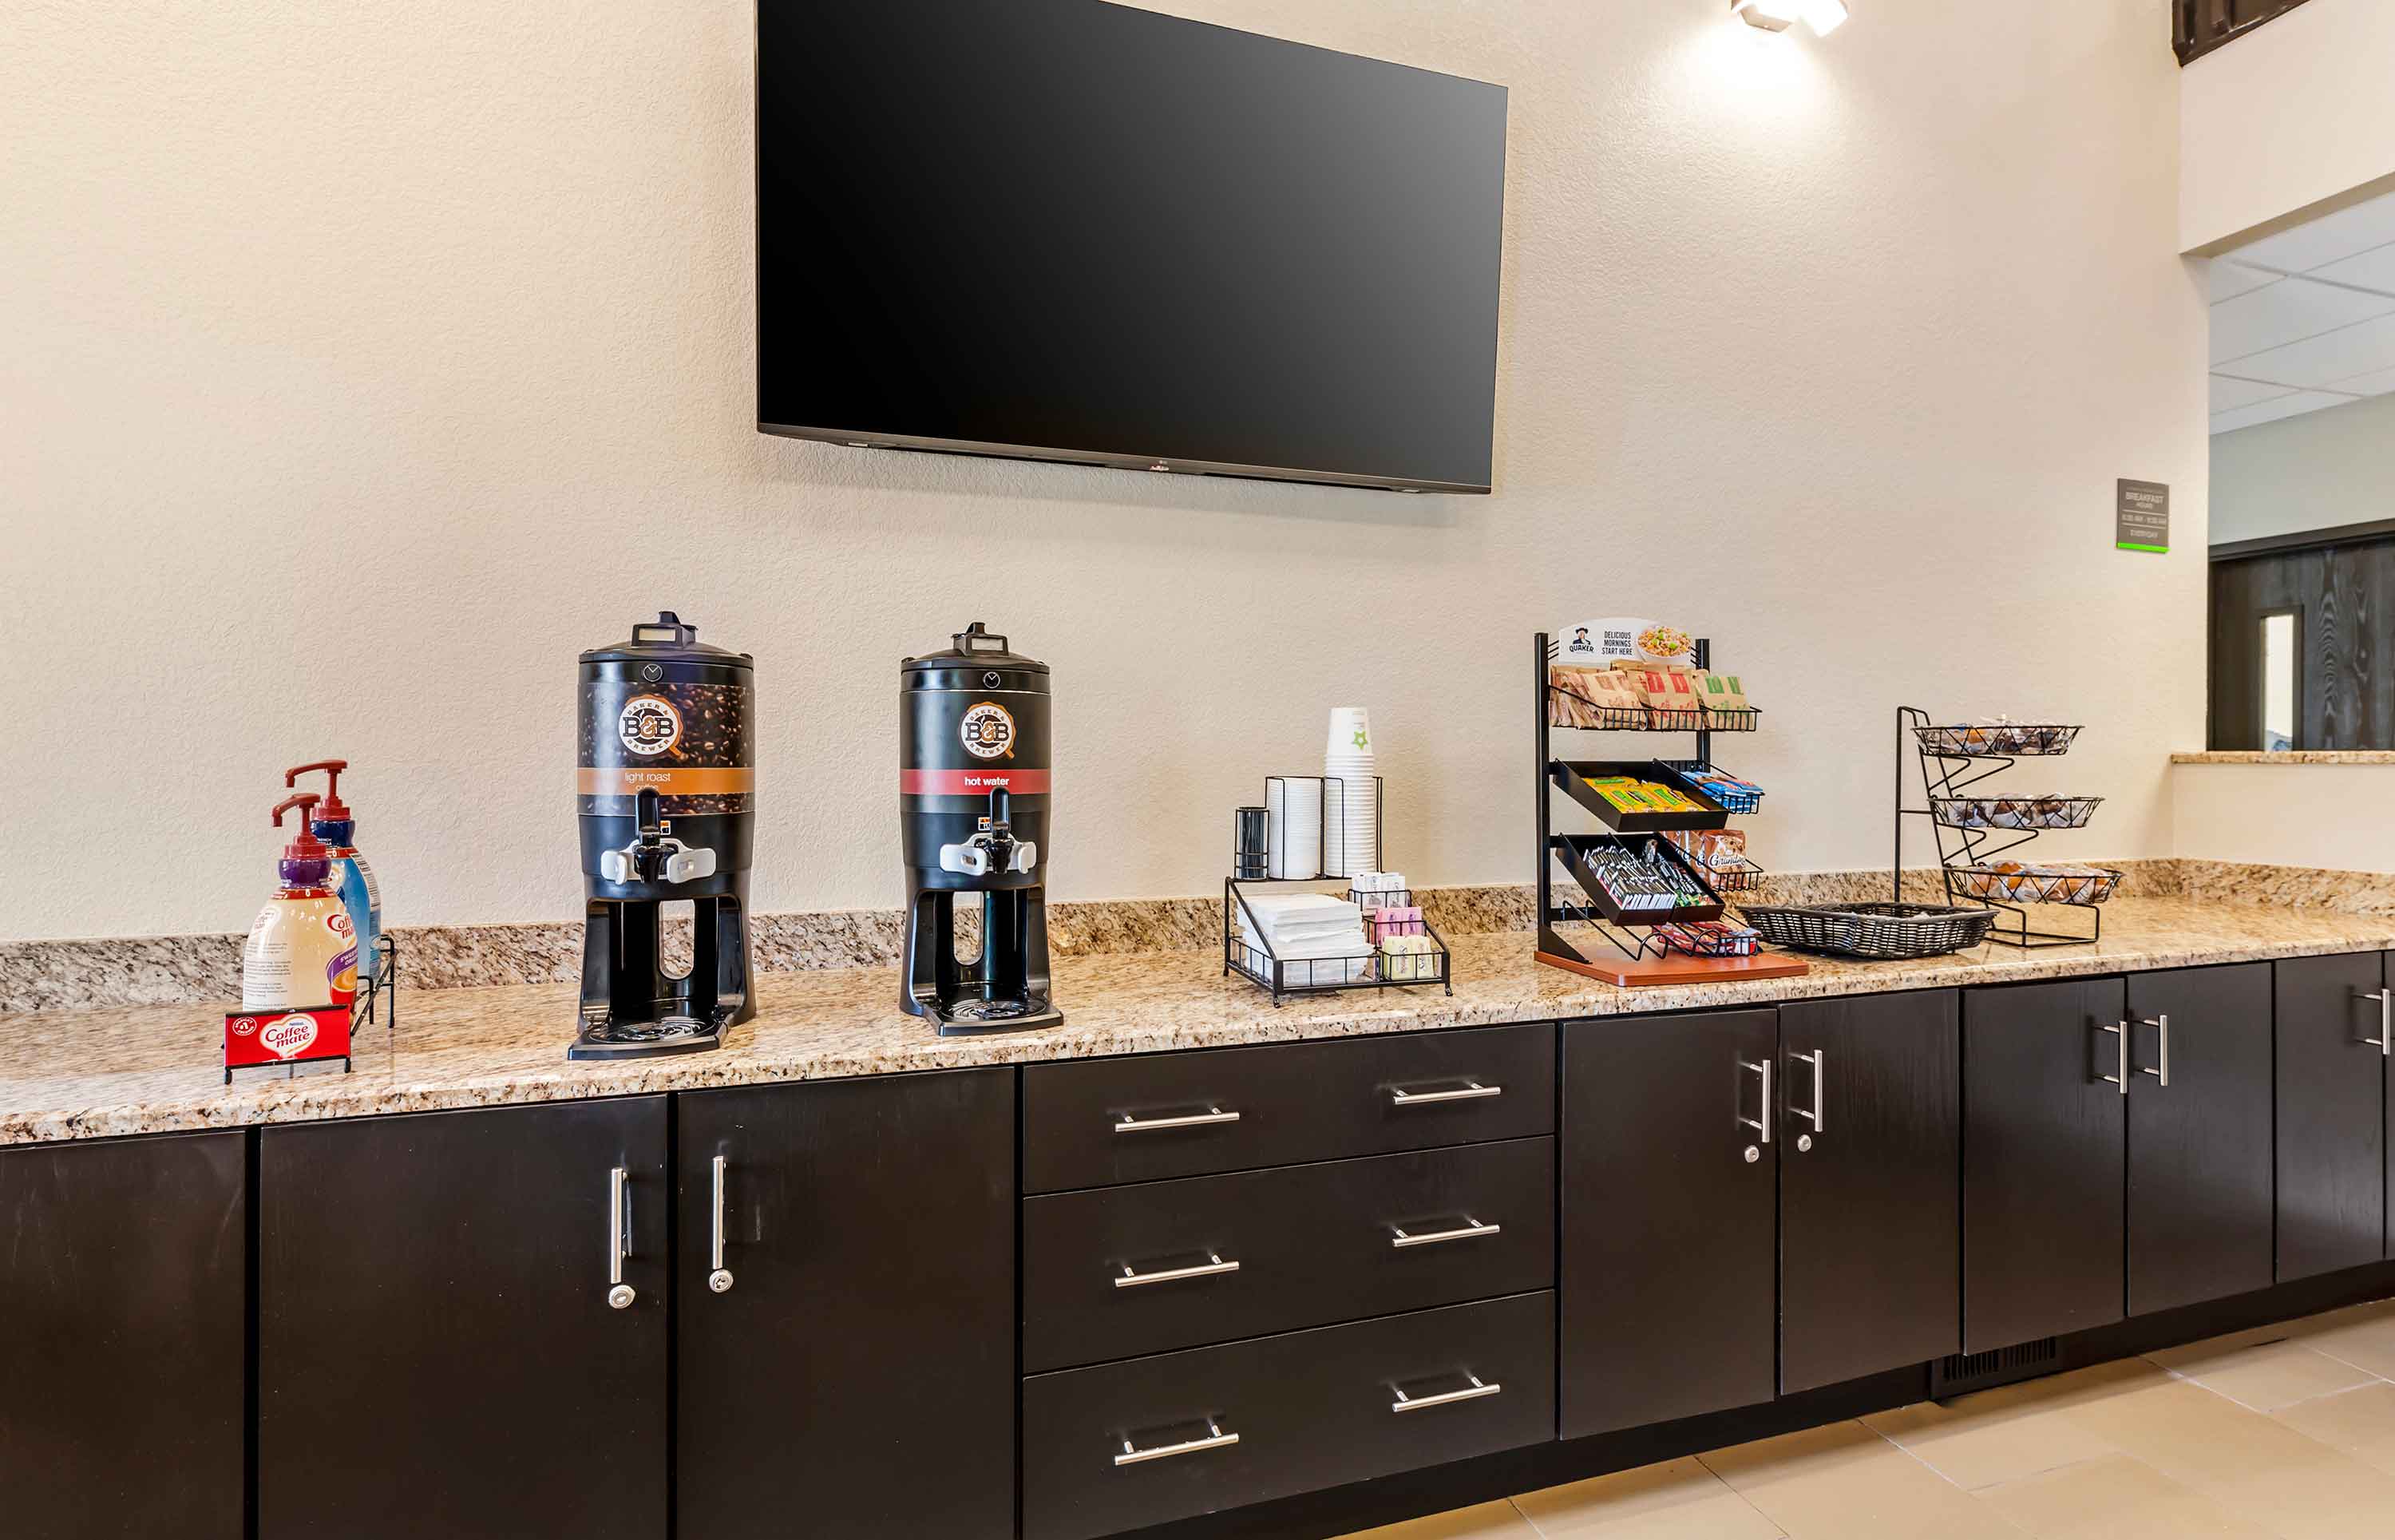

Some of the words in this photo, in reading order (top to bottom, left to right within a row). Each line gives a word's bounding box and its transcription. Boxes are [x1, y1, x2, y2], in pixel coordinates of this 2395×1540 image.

[1604, 631, 1632, 639] DELICIOUS
[1569, 644, 1595, 653] QUAKER
[1601, 647, 1617, 655] START
[623, 715, 675, 739] B&B
[964, 721, 1010, 742] B&B
[627, 738, 671, 752] BREWER
[624, 772, 644, 783] light
[646, 772, 671, 782] roast
[964, 777, 982, 786] hot
[983, 777, 1010, 786] water
[265, 1025, 309, 1043] Coffee
[276, 1032, 311, 1048] mate
